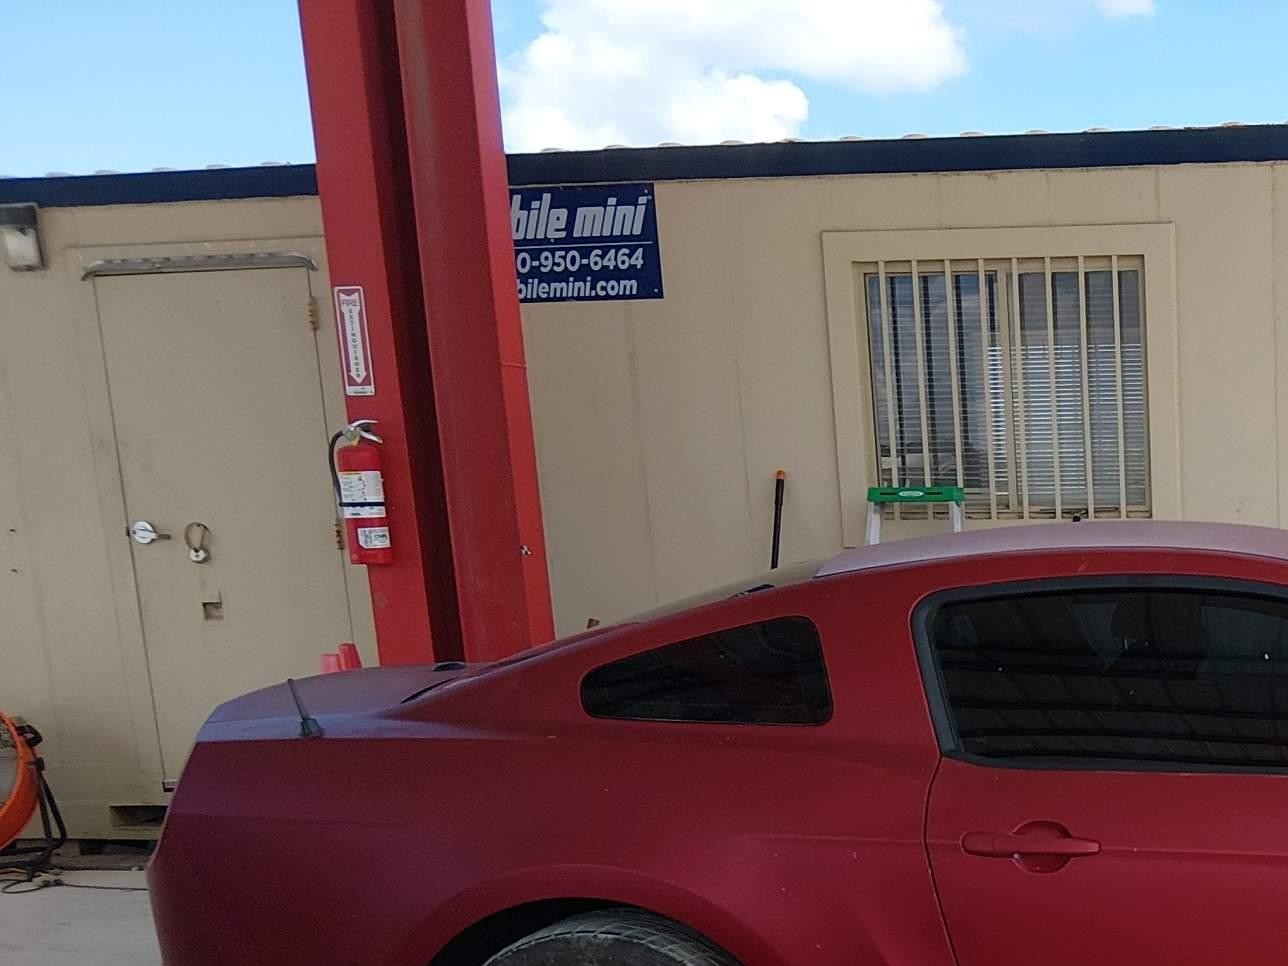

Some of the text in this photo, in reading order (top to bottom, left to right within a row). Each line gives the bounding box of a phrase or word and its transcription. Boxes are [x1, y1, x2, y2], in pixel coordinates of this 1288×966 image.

[572, 195, 647, 238] mini
[517, 247, 644, 274] 0-950-6464
[341, 298, 358, 307] FIRE
